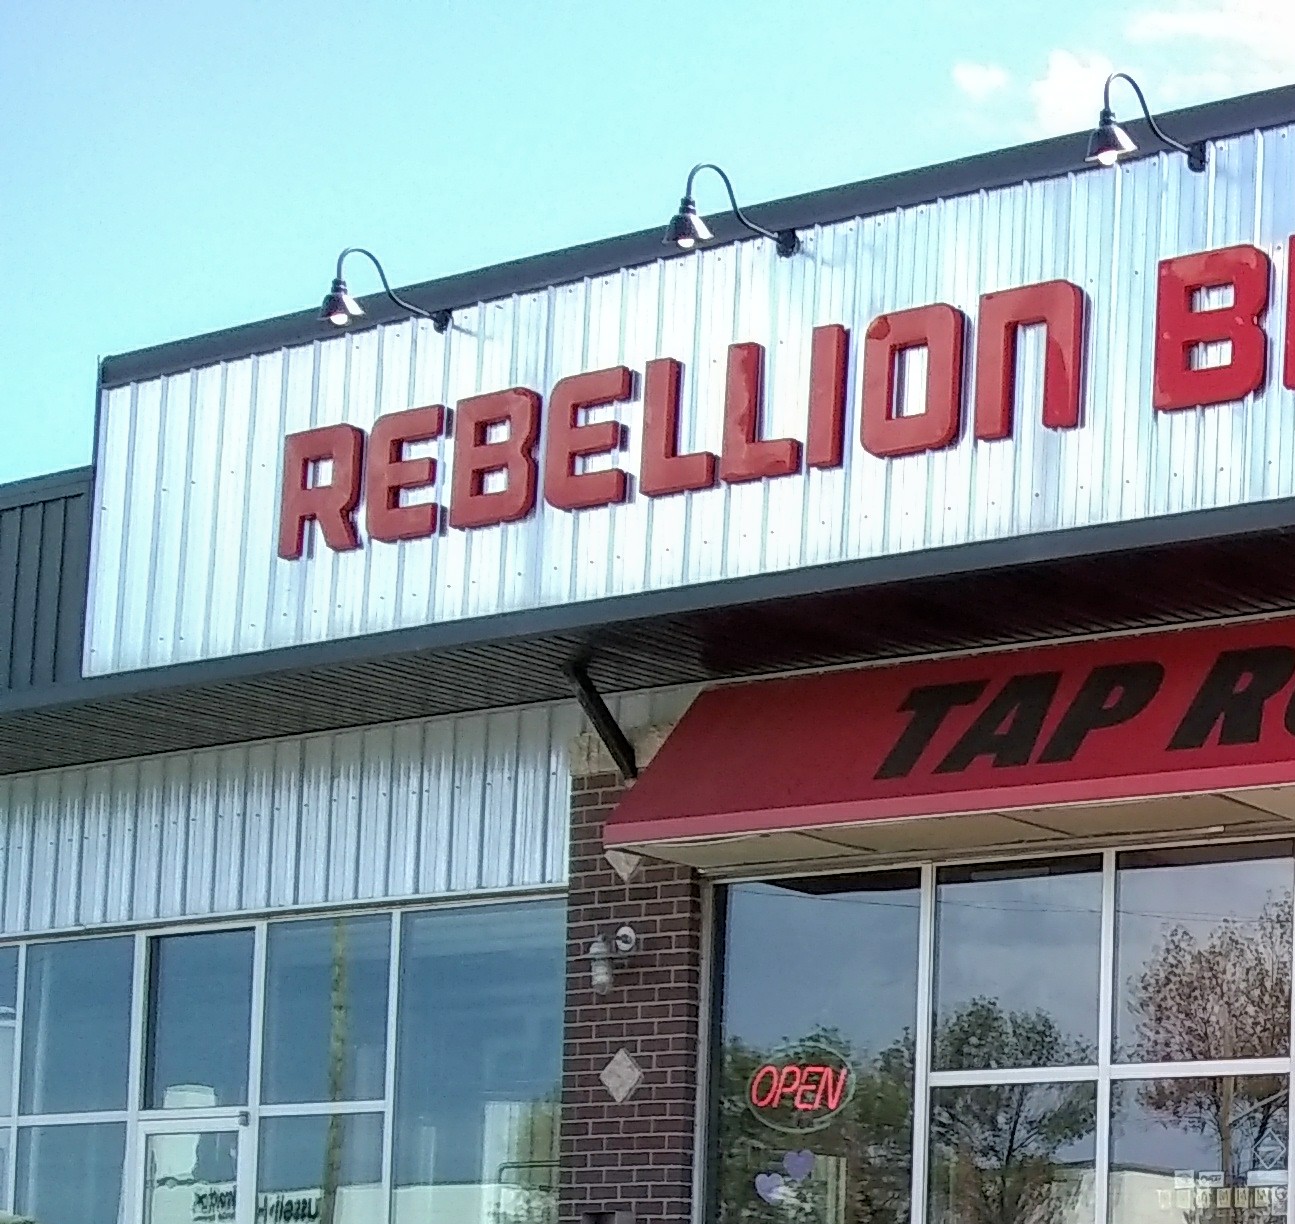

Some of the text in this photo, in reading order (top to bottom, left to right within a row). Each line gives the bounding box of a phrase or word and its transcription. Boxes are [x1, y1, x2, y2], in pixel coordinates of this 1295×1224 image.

[277, 278, 1086, 560] REBELLION
[873, 660, 1164, 780] TAP
[751, 1064, 848, 1110] OPEN
